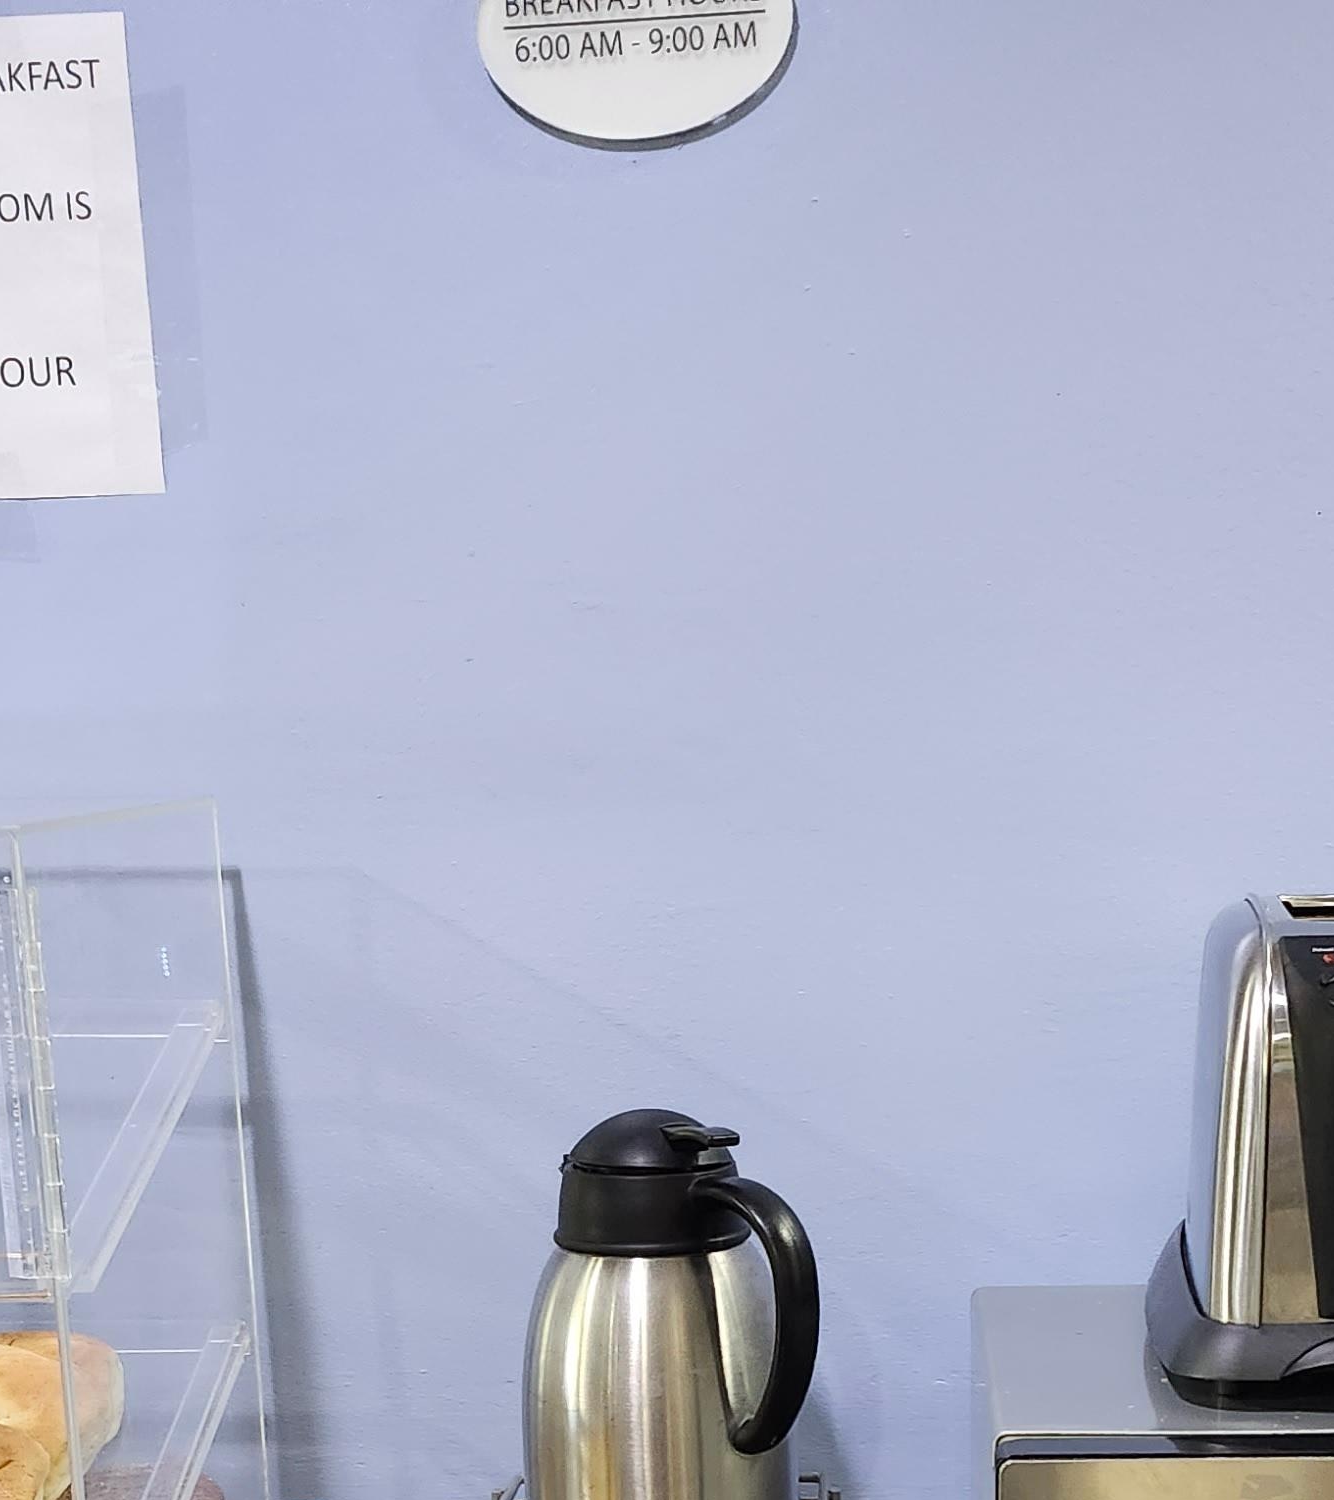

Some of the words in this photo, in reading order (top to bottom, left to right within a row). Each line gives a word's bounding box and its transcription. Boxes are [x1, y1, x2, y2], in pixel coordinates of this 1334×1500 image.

[515, 34, 570, 62] 6:00
[579, 30, 623, 58] AM
[648, 25, 704, 54] 9:00
[713, 21, 757, 50] AM
[66, 190, 92, 221] IS
